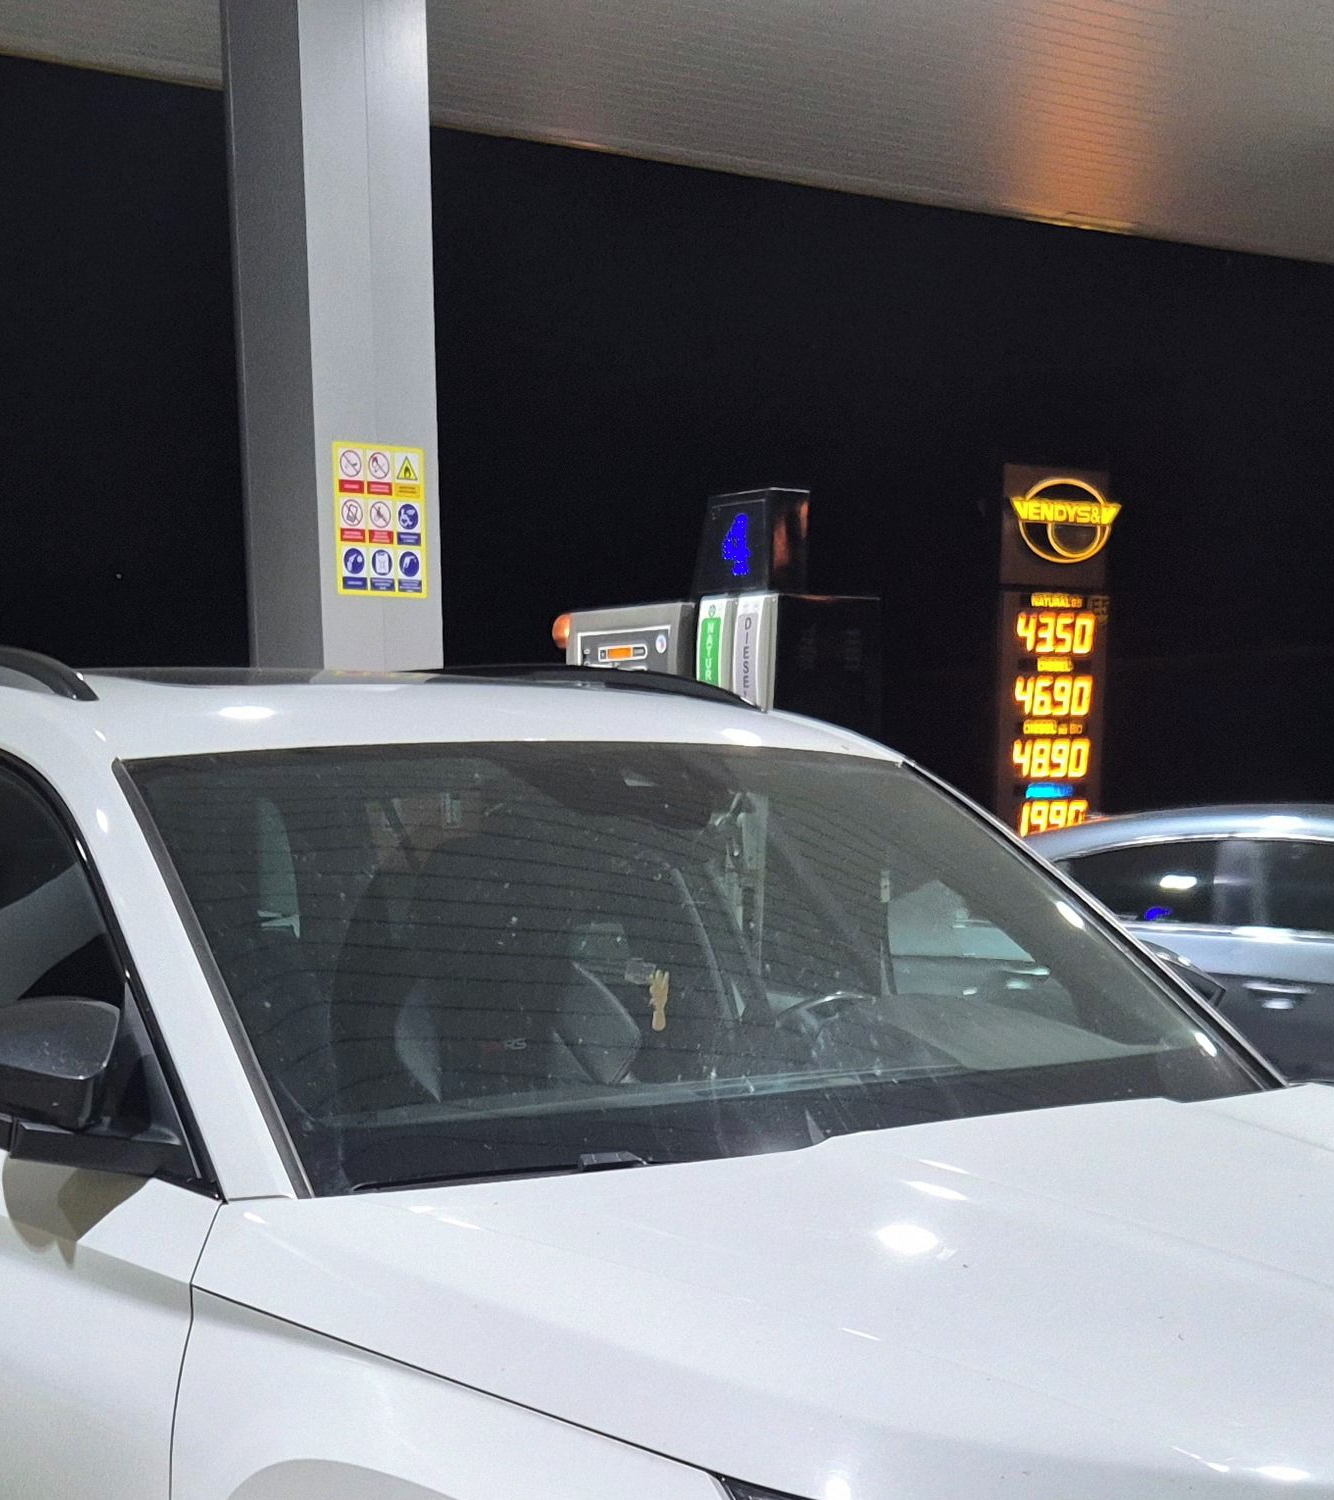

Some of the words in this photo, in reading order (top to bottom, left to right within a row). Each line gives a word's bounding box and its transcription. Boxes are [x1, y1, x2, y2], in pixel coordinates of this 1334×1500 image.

[1010, 497, 1122, 525] VENDYS&V
[722, 513, 751, 576] 4
[741, 617, 753, 698] DIESE
